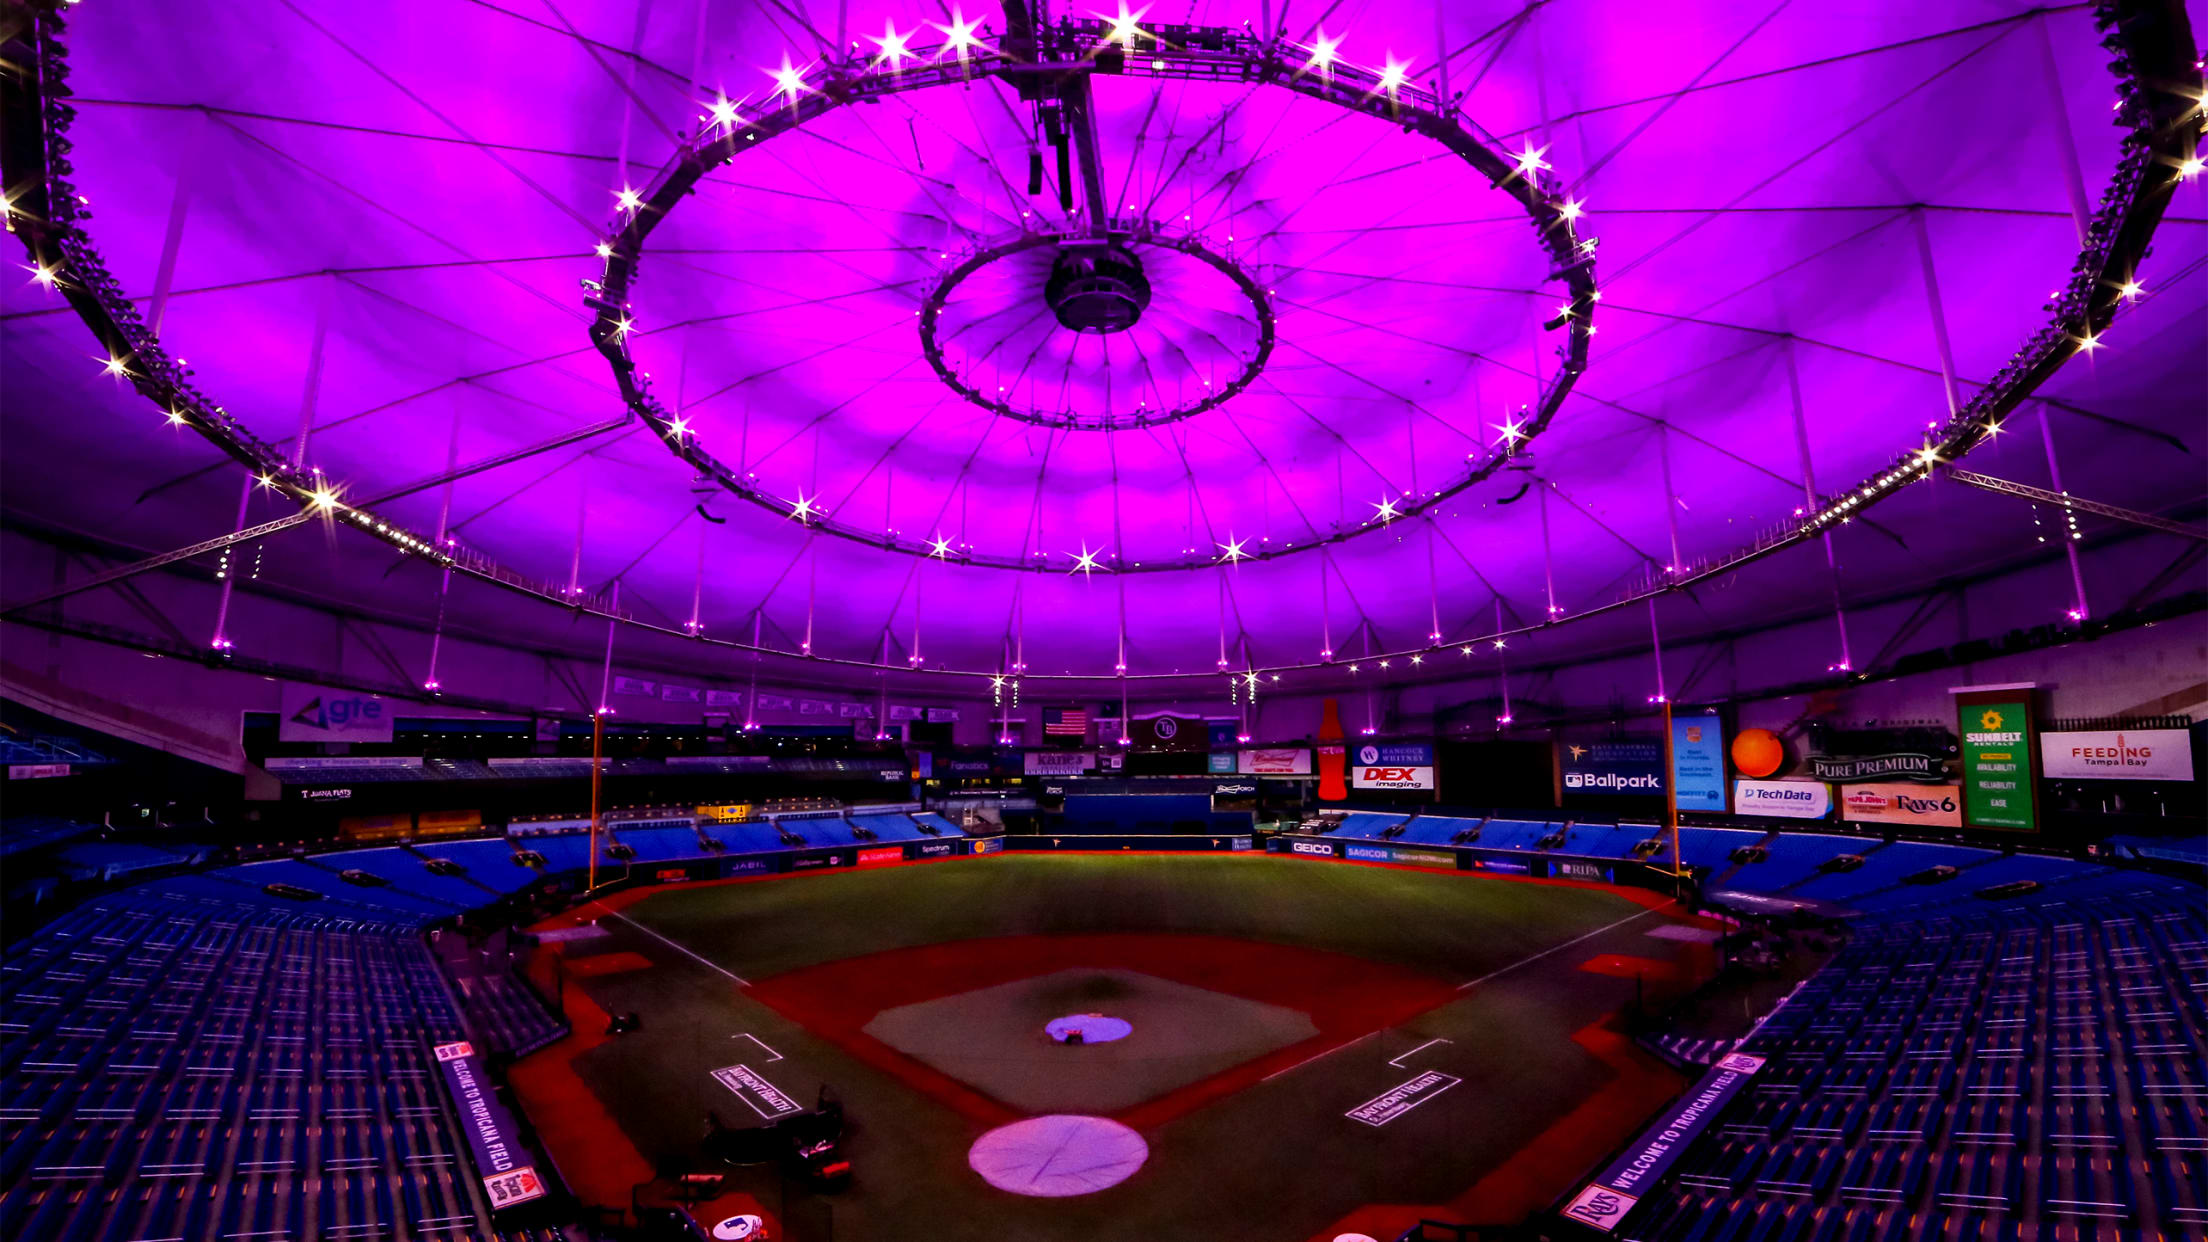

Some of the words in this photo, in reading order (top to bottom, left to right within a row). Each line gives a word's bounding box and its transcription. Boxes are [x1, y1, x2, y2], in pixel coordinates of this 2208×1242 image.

[329, 698, 382, 723] gte
[1966, 732, 2022, 743] SUNBELT
[2072, 747, 2152, 758] FEEDING
[1814, 761, 1853, 778] PURE
[1855, 757, 1929, 776] PREMIUM
[1976, 763, 2017, 772] AVAILABILITY
[2127, 759, 2148, 767] Bay
[1363, 768, 1417, 781] DEX
[1375, 781, 1422, 789] imaging
[1584, 773, 1660, 791] Ballpark
[1978, 781, 2017, 790] RELIABILITY
[1756, 789, 1783, 799] Tech
[1783, 790, 1812, 801] Data
[1895, 795, 1940, 814] RAYS
[1941, 796, 1957, 813] 6
[1990, 799, 2007, 808] EASE
[922, 844, 950, 855] Spectrum
[1292, 842, 1332, 855] GEICO
[1347, 847, 1388, 859] SAGICOR
[732, 859, 767, 871] JABIL
[1571, 864, 1601, 877] RIPA
[451, 1058, 477, 1089] WELCOME
[463, 1087, 481, 1099] TO
[468, 1098, 501, 1144] TROPICANA
[1611, 1141, 1671, 1189] WELCOME
[1658, 1130, 1681, 1143] TO
[1670, 1088, 1722, 1131] TROPICANA
[1715, 1071, 1738, 1090] FIELD
[486, 1142, 513, 1172] FIELD
[1571, 1192, 1620, 1222] RAYS
